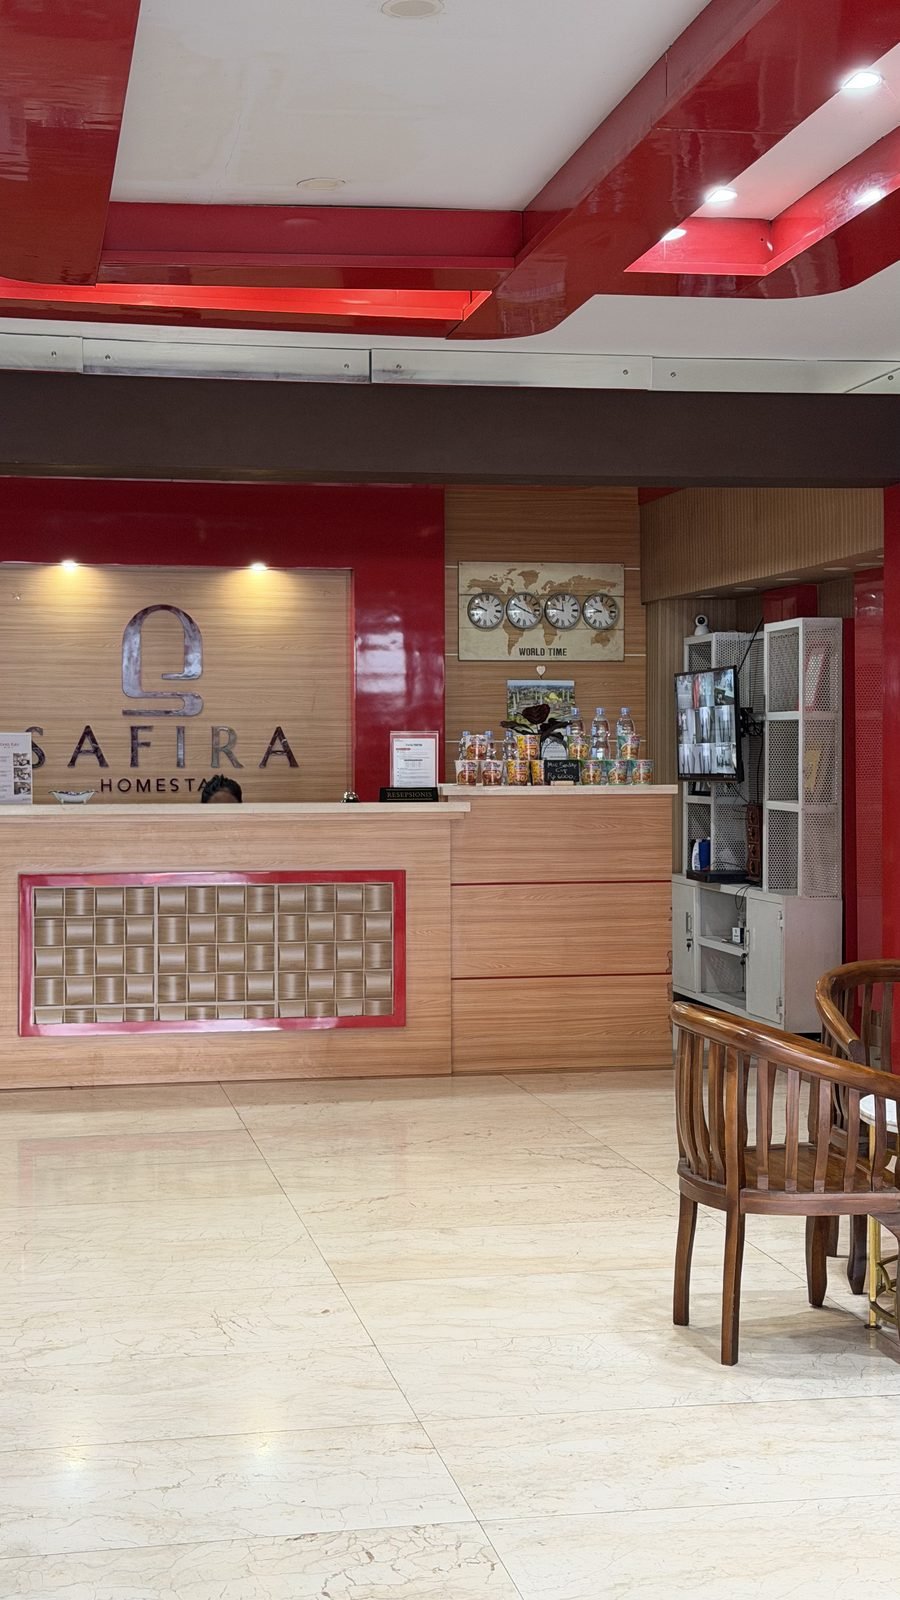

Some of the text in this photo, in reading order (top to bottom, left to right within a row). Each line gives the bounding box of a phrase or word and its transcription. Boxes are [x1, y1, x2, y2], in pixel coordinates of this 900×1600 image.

[519, 647, 568, 657] WORLD TIME
[25, 725, 299, 769] SAFIRA
[100, 778, 209, 793] HOMESTA
